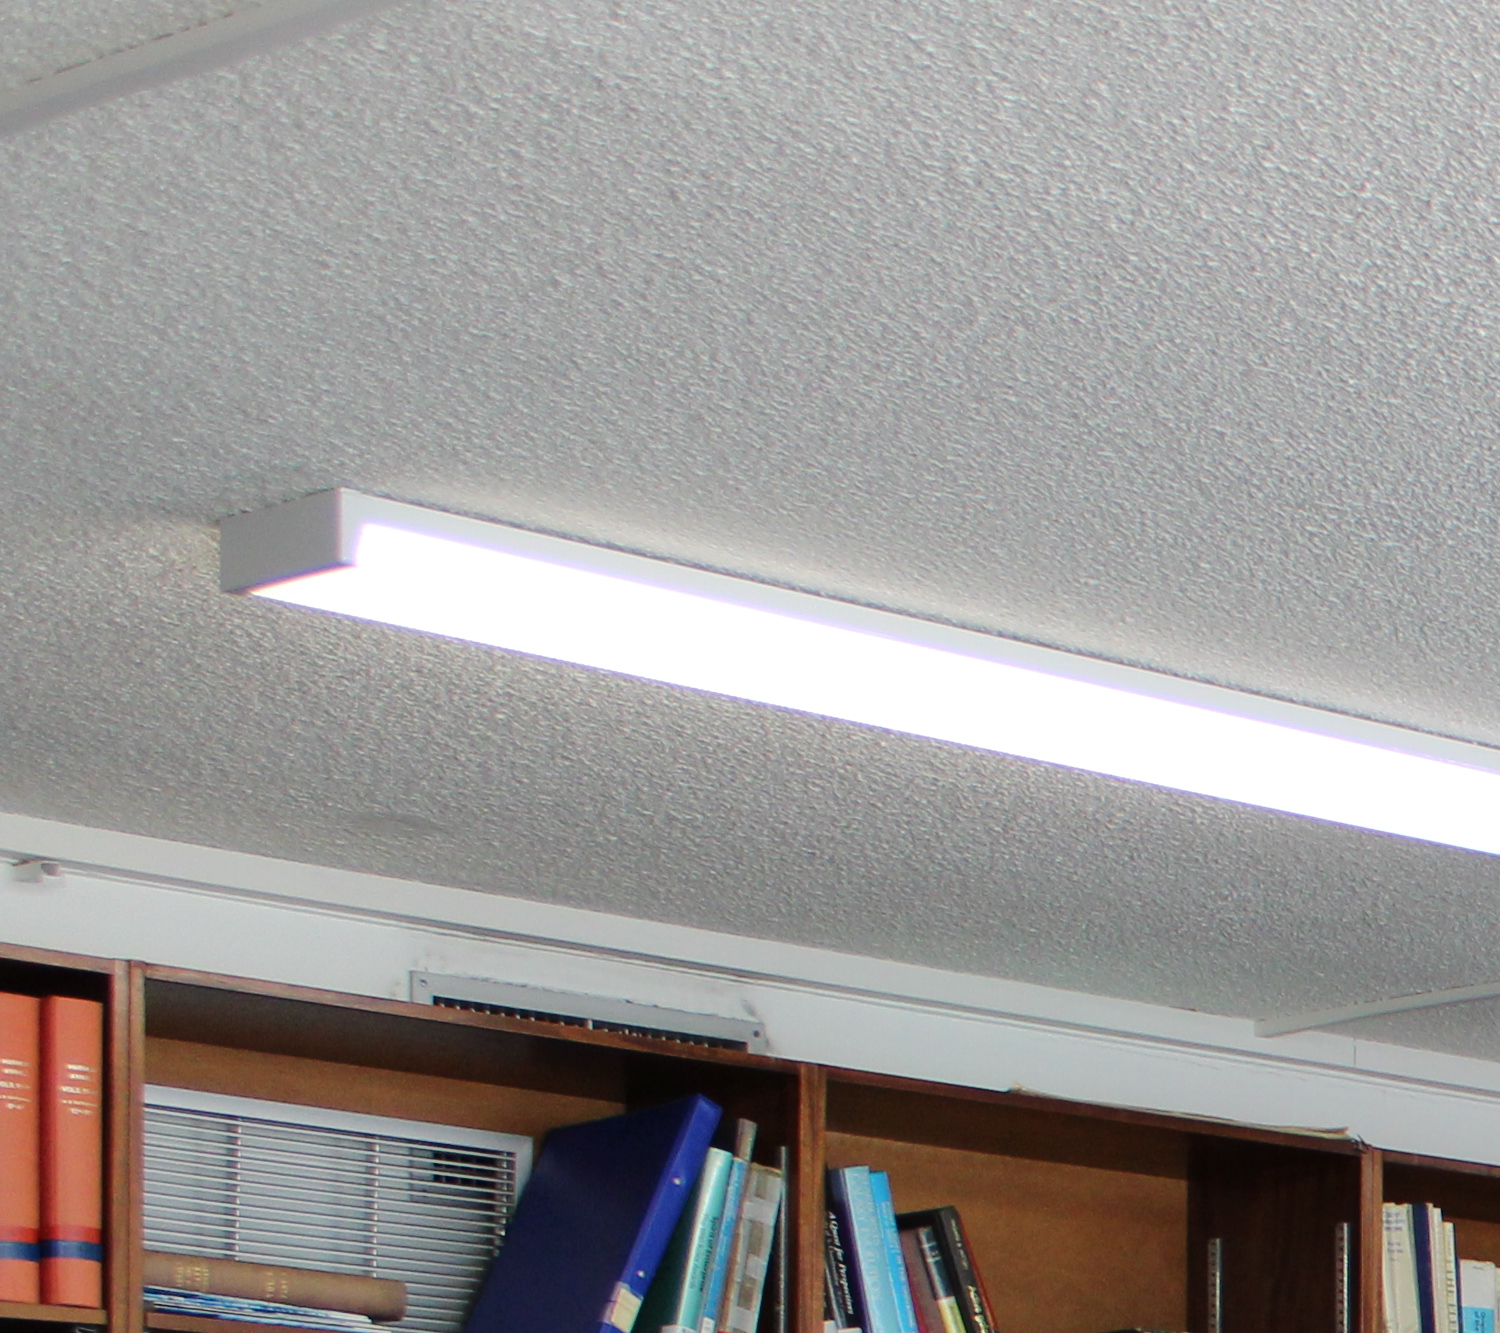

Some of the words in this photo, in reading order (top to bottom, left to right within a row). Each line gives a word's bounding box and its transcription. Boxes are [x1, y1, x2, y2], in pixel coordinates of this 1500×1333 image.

[829, 1220, 845, 1246] Quest
[831, 1247, 846, 1262] for
[1446, 1270, 1457, 1297] THE
